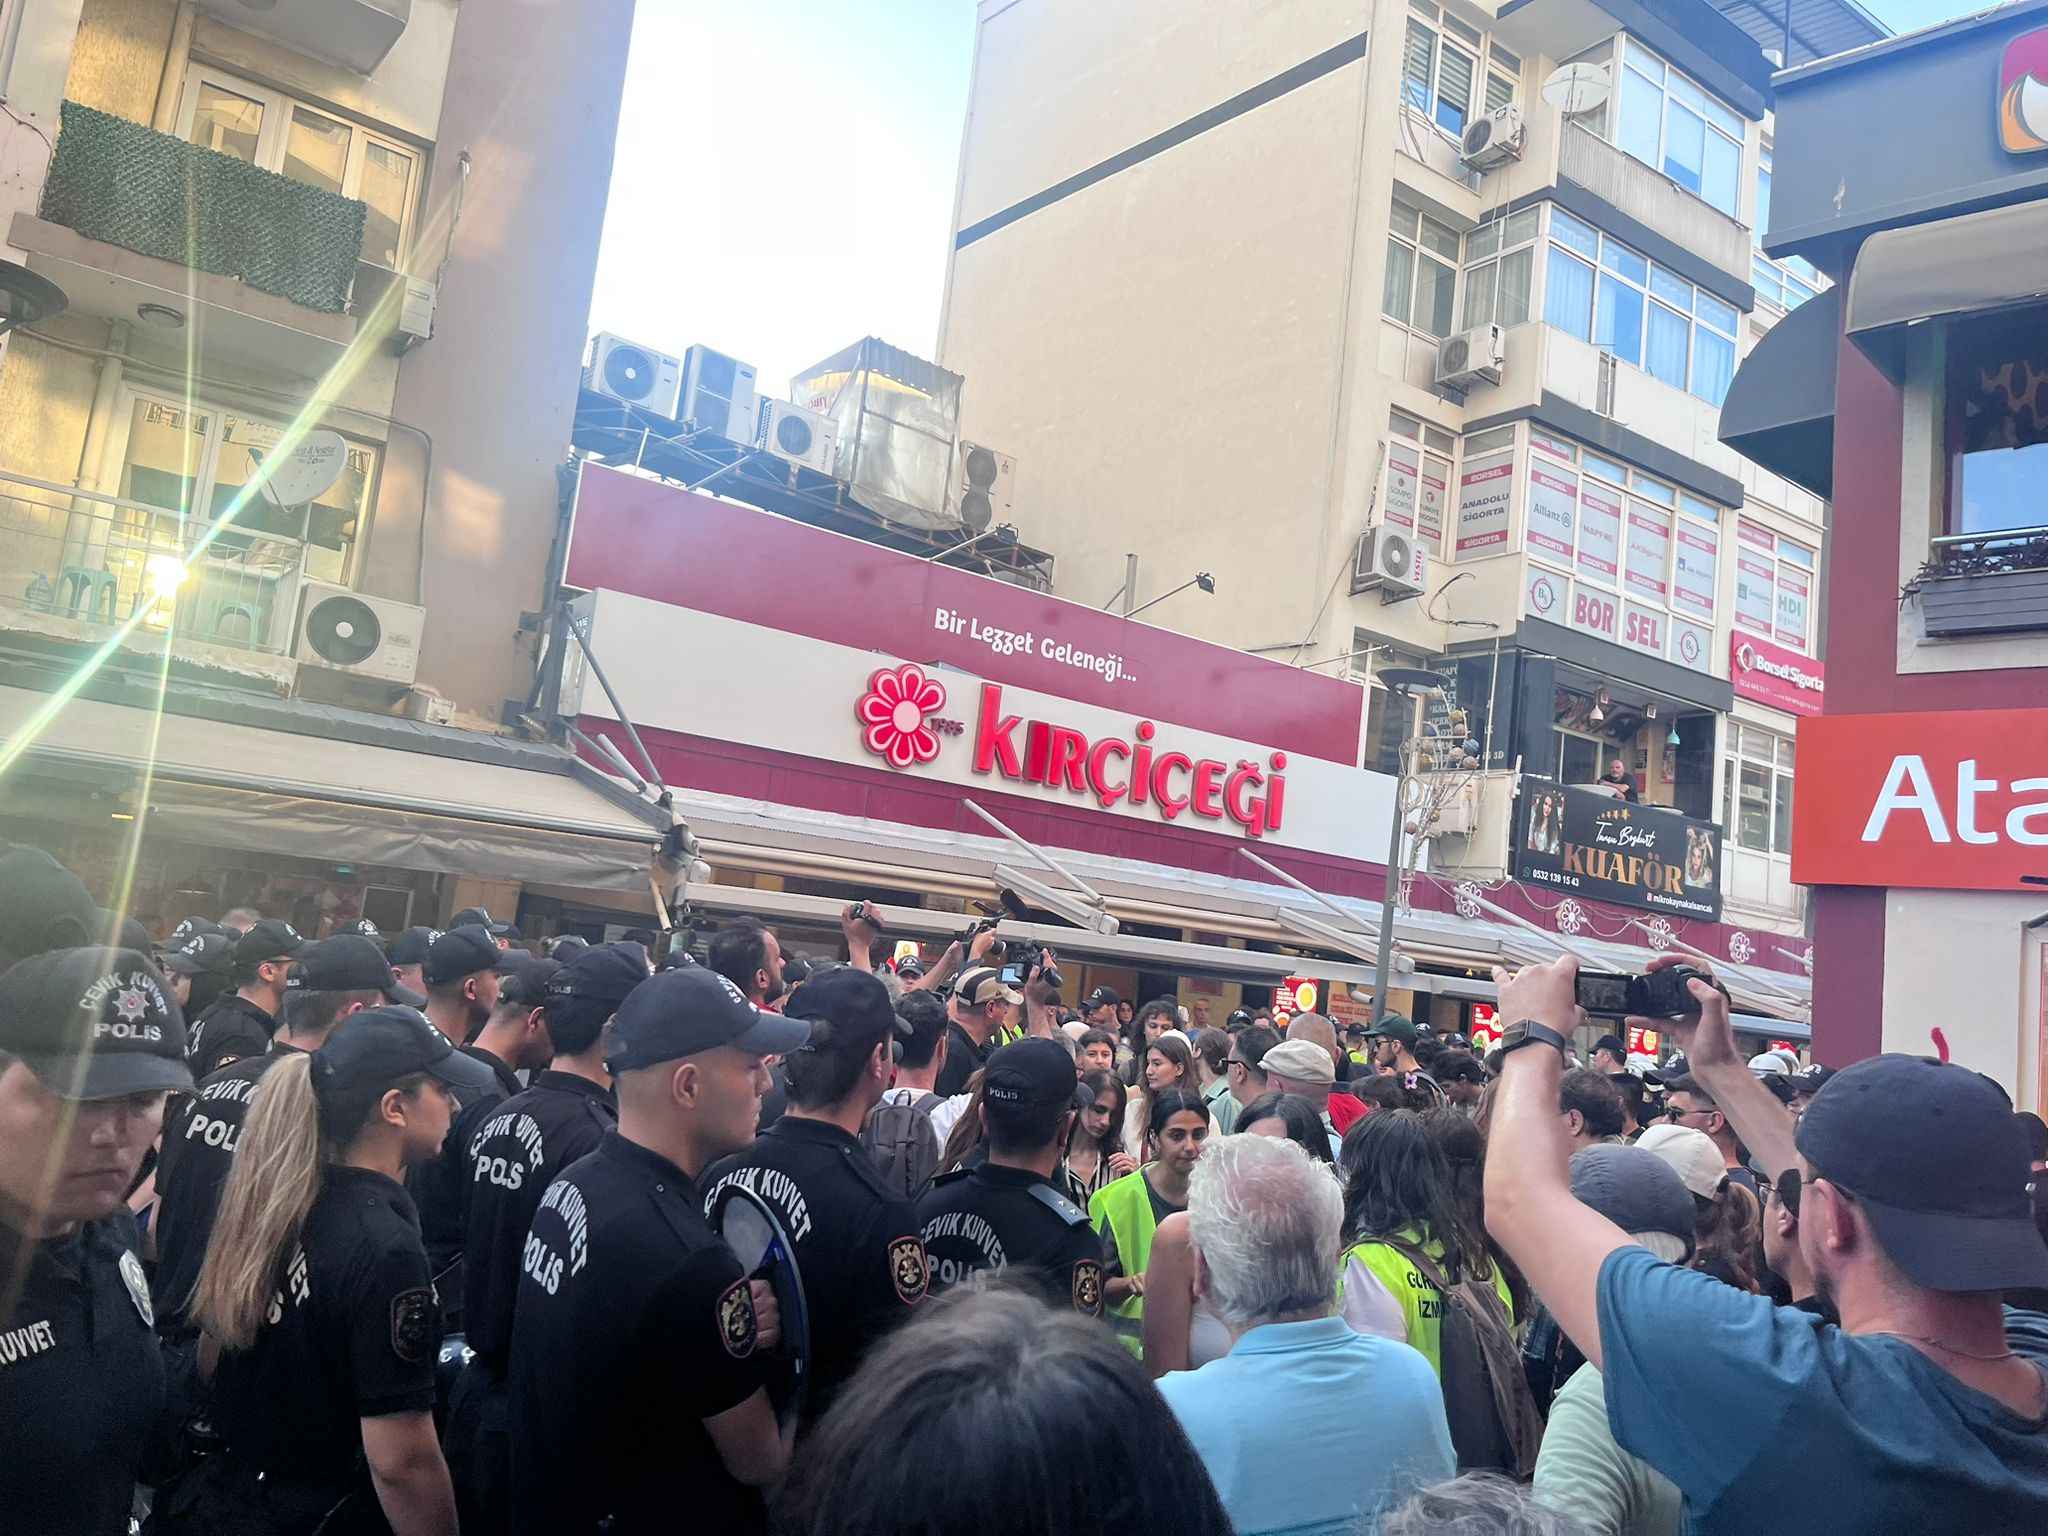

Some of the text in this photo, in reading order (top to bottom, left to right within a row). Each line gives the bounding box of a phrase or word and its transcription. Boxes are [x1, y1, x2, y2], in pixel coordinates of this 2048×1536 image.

[1462, 493, 1510, 510] ANADOLU
[1533, 502, 1561, 522] Allianz
[1575, 592, 1660, 650] BOR SEL
[1778, 594, 1801, 617] HDI
[934, 607, 966, 635] Bir
[970, 617, 1034, 656] Lezzet
[1756, 655, 1789, 681] Borsel
[1789, 666, 1824, 692] Sigorta
[1532, 869, 1549, 880] 0532
[1563, 875, 1571, 885] 15
[1561, 841, 1684, 895] KUAFÖR
[130, 971, 168, 1015] KUVVET
[760, 1168, 812, 1242] KUVVET
[558, 1184, 588, 1278] KUVVET
